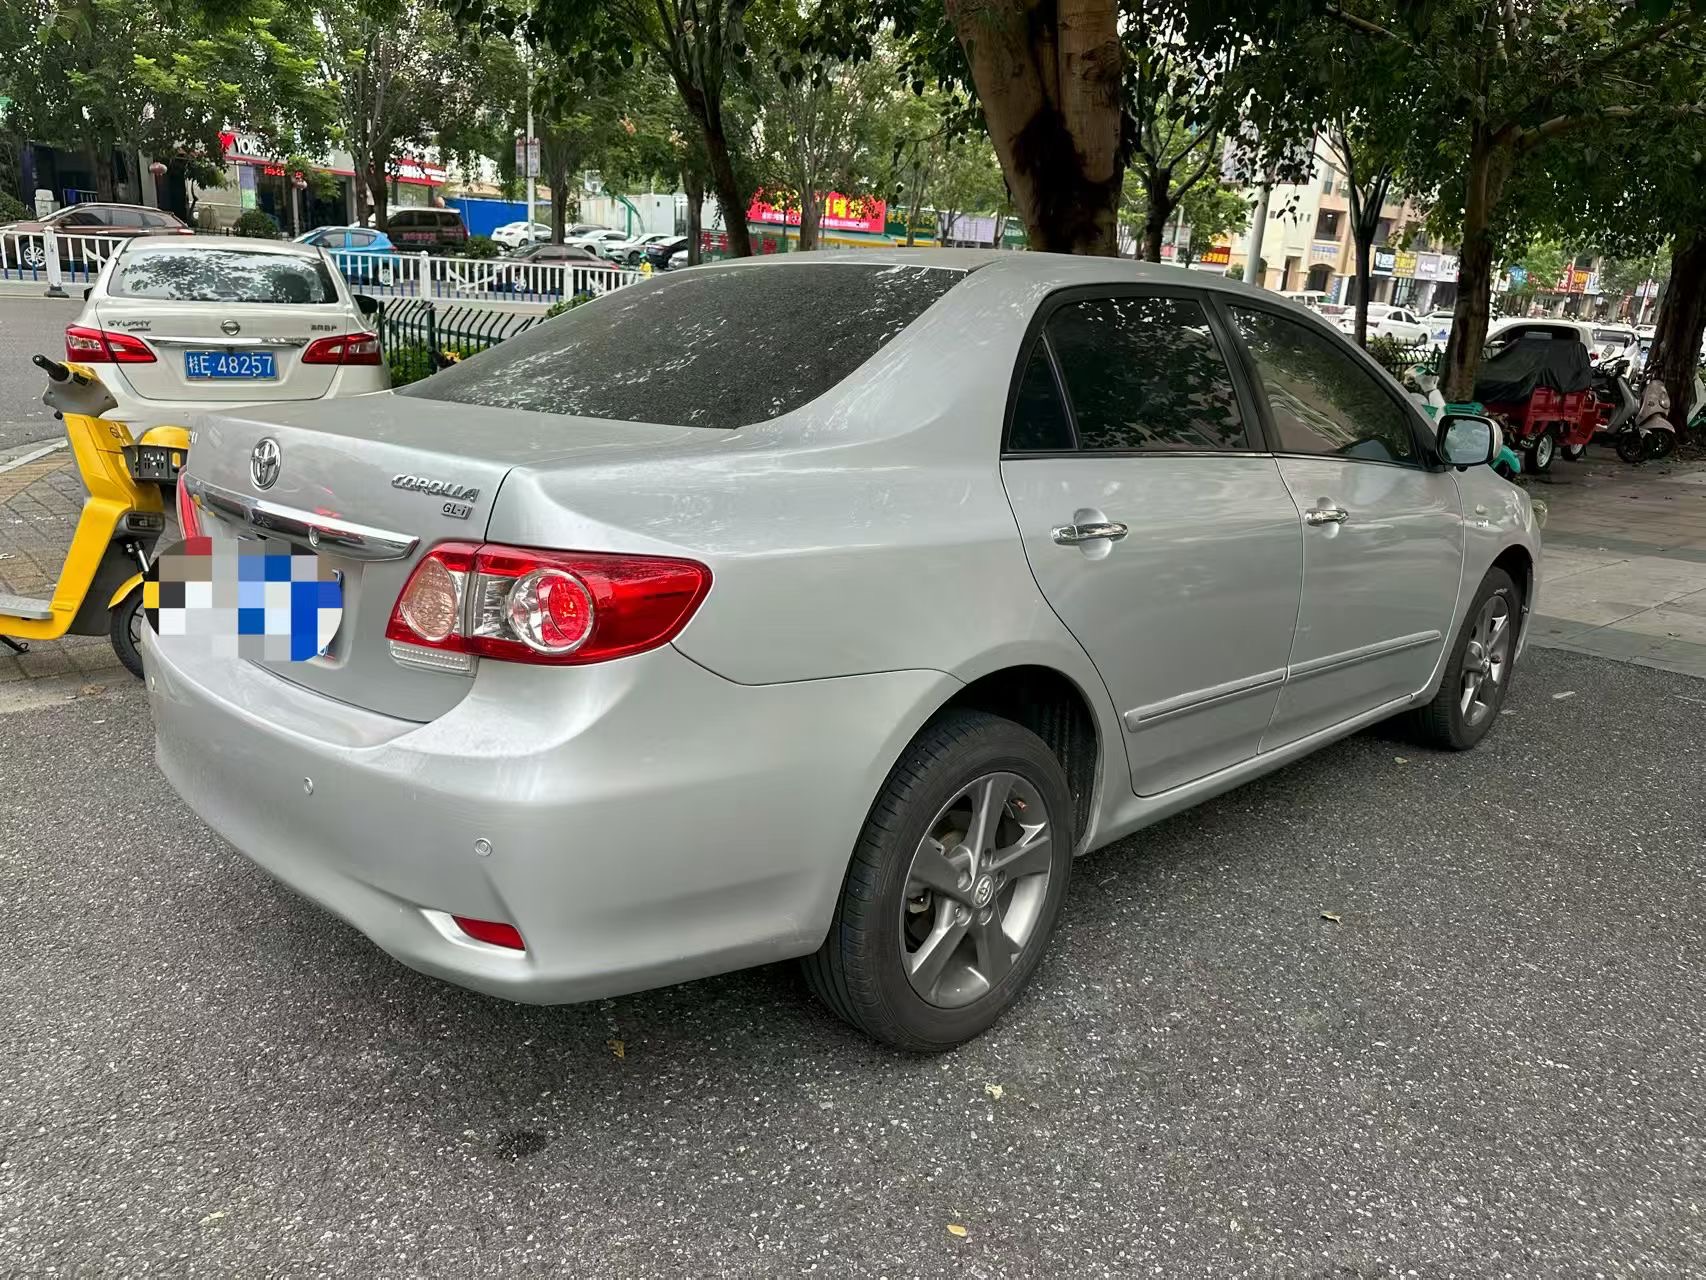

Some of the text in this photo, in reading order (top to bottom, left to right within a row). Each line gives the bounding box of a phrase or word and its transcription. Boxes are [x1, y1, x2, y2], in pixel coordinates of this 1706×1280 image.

[107, 320, 152, 328] SYLPHY
[391, 474, 480, 503] COROLLA
[442, 502, 467, 517] GL-i
